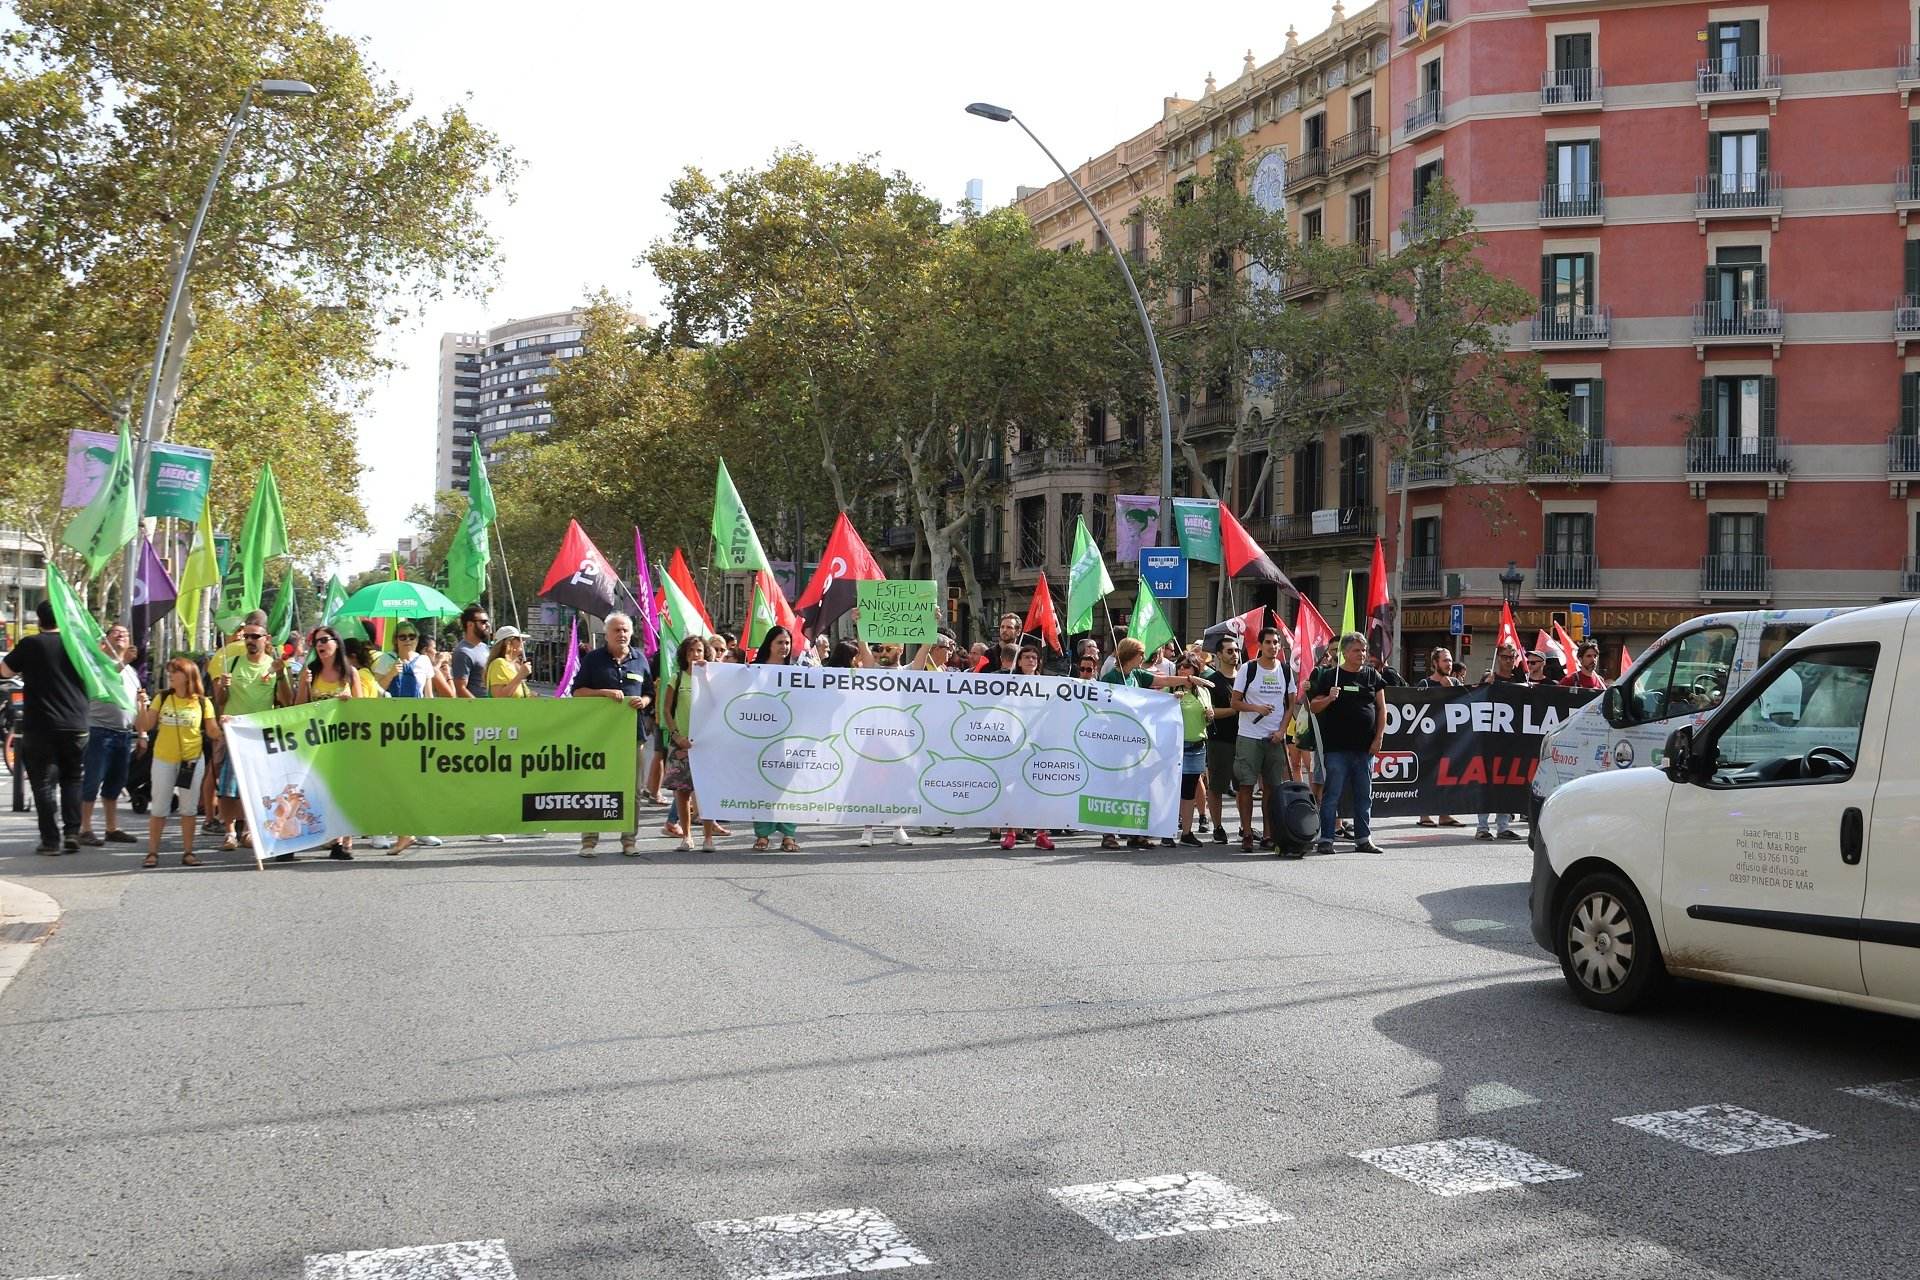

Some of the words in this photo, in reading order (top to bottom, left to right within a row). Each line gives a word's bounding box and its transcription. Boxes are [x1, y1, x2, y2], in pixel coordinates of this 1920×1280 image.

[876, 582, 917, 598] ESTEU
[1155, 580, 1172, 590] taxi
[873, 612, 923, 624] L'ESCOLA
[1454, 609, 1460, 620] P
[868, 623, 926, 638] PÚBLICA
[777, 671, 782, 688] I
[790, 672, 815, 689] EL
[823, 674, 940, 694] PERSONAL
[947, 678, 1051, 701] LABORAL,
[738, 711, 777, 722] JULIOL
[1444, 702, 1515, 734] PER
[1523, 704, 1560, 735] LA
[854, 727, 875, 736] TEEI
[877, 728, 915, 737] RURALS
[970, 721, 982, 730] 1/3
[993, 722, 1005, 731] 1/2
[262, 724, 298, 754] Els
[305, 718, 372, 747] diners
[380, 713, 466, 747] públics
[473, 726, 503, 745] per
[507, 726, 519, 740] a
[964, 734, 1011, 743] JORNADA
[1079, 730, 1121, 741] CALENDARI
[1122, 736, 1147, 745] LLARS
[785, 749, 817, 757] PACTE
[420, 745, 512, 773] l'escola
[521, 744, 606, 778] pública
[762, 760, 840, 771] ESTABILITZACIÓ
[1033, 761, 1075, 770] HORARIS
[1371, 756, 1414, 779] CGT
[1032, 773, 1081, 783] FUNCIONS
[924, 779, 998, 790] RECLASSIFICACIÓ
[952, 791, 969, 799] PAE
[1372, 788, 1419, 803] senyament
[720, 799, 922, 815] #AmbFermesaPelPersonalLaboral
[603, 810, 618, 818] IAC
[1743, 828, 1760, 838] Isaac
[1794, 832, 1799, 841] B
[1767, 842, 1783, 851] Mas
[1785, 843, 1807, 855] Roger
[1752, 875, 1780, 887] PINEDA
[1783, 879, 1793, 888] DE
[1796, 880, 1814, 890] MAR
